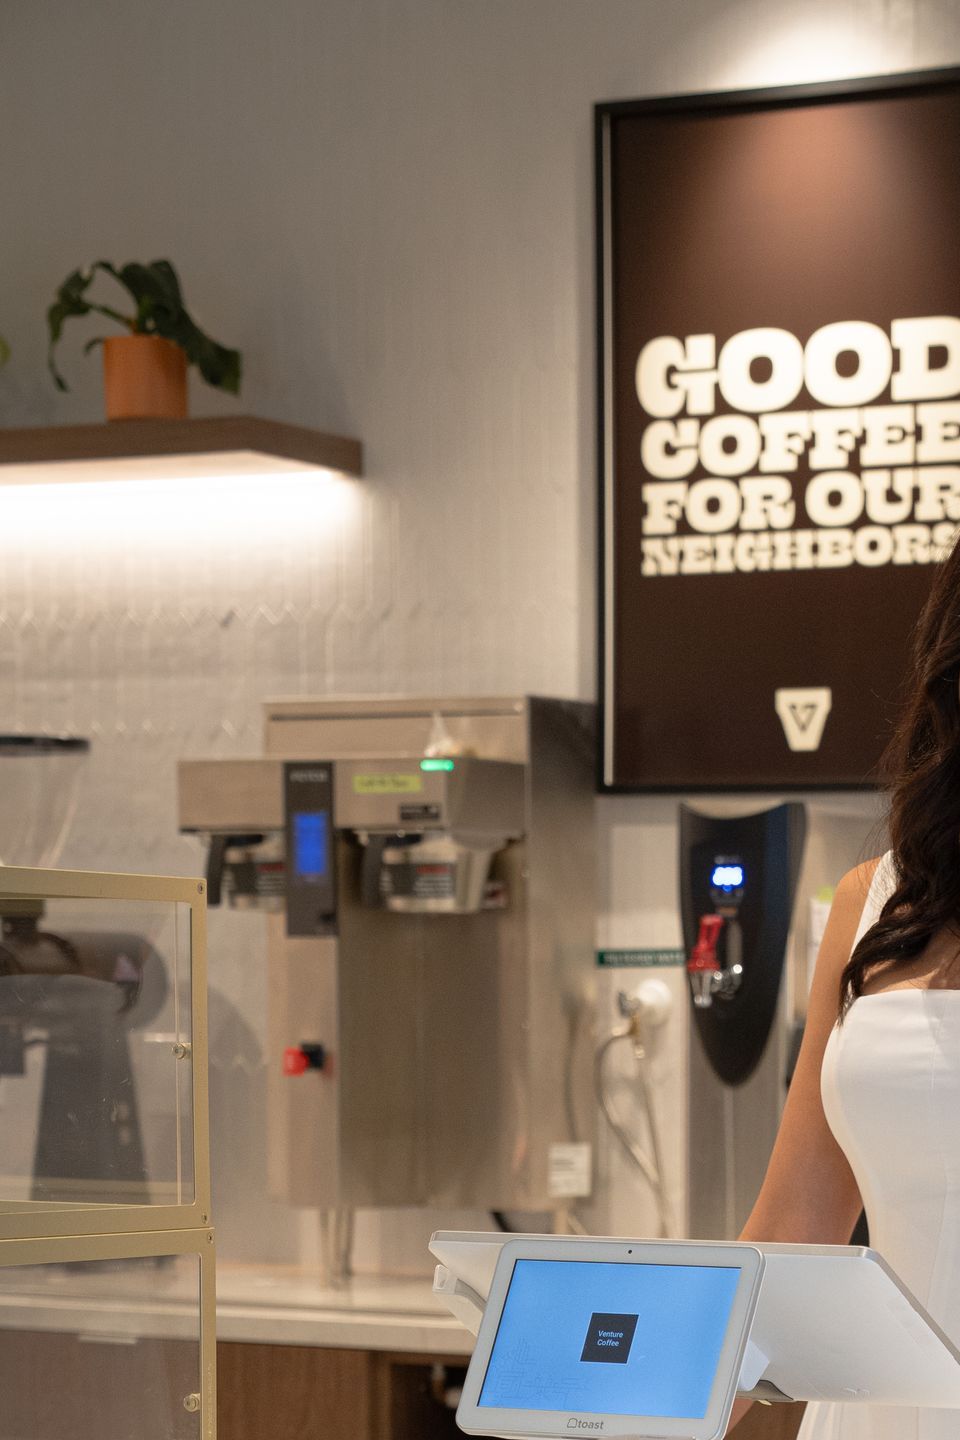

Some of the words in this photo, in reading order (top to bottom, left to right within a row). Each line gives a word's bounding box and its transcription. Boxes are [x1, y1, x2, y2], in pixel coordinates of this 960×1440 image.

[642, 475, 795, 535] FOR
[598, 1330, 624, 1338] Venture
[597, 1339, 620, 1347] Coffee
[578, 1420, 604, 1430] toast
